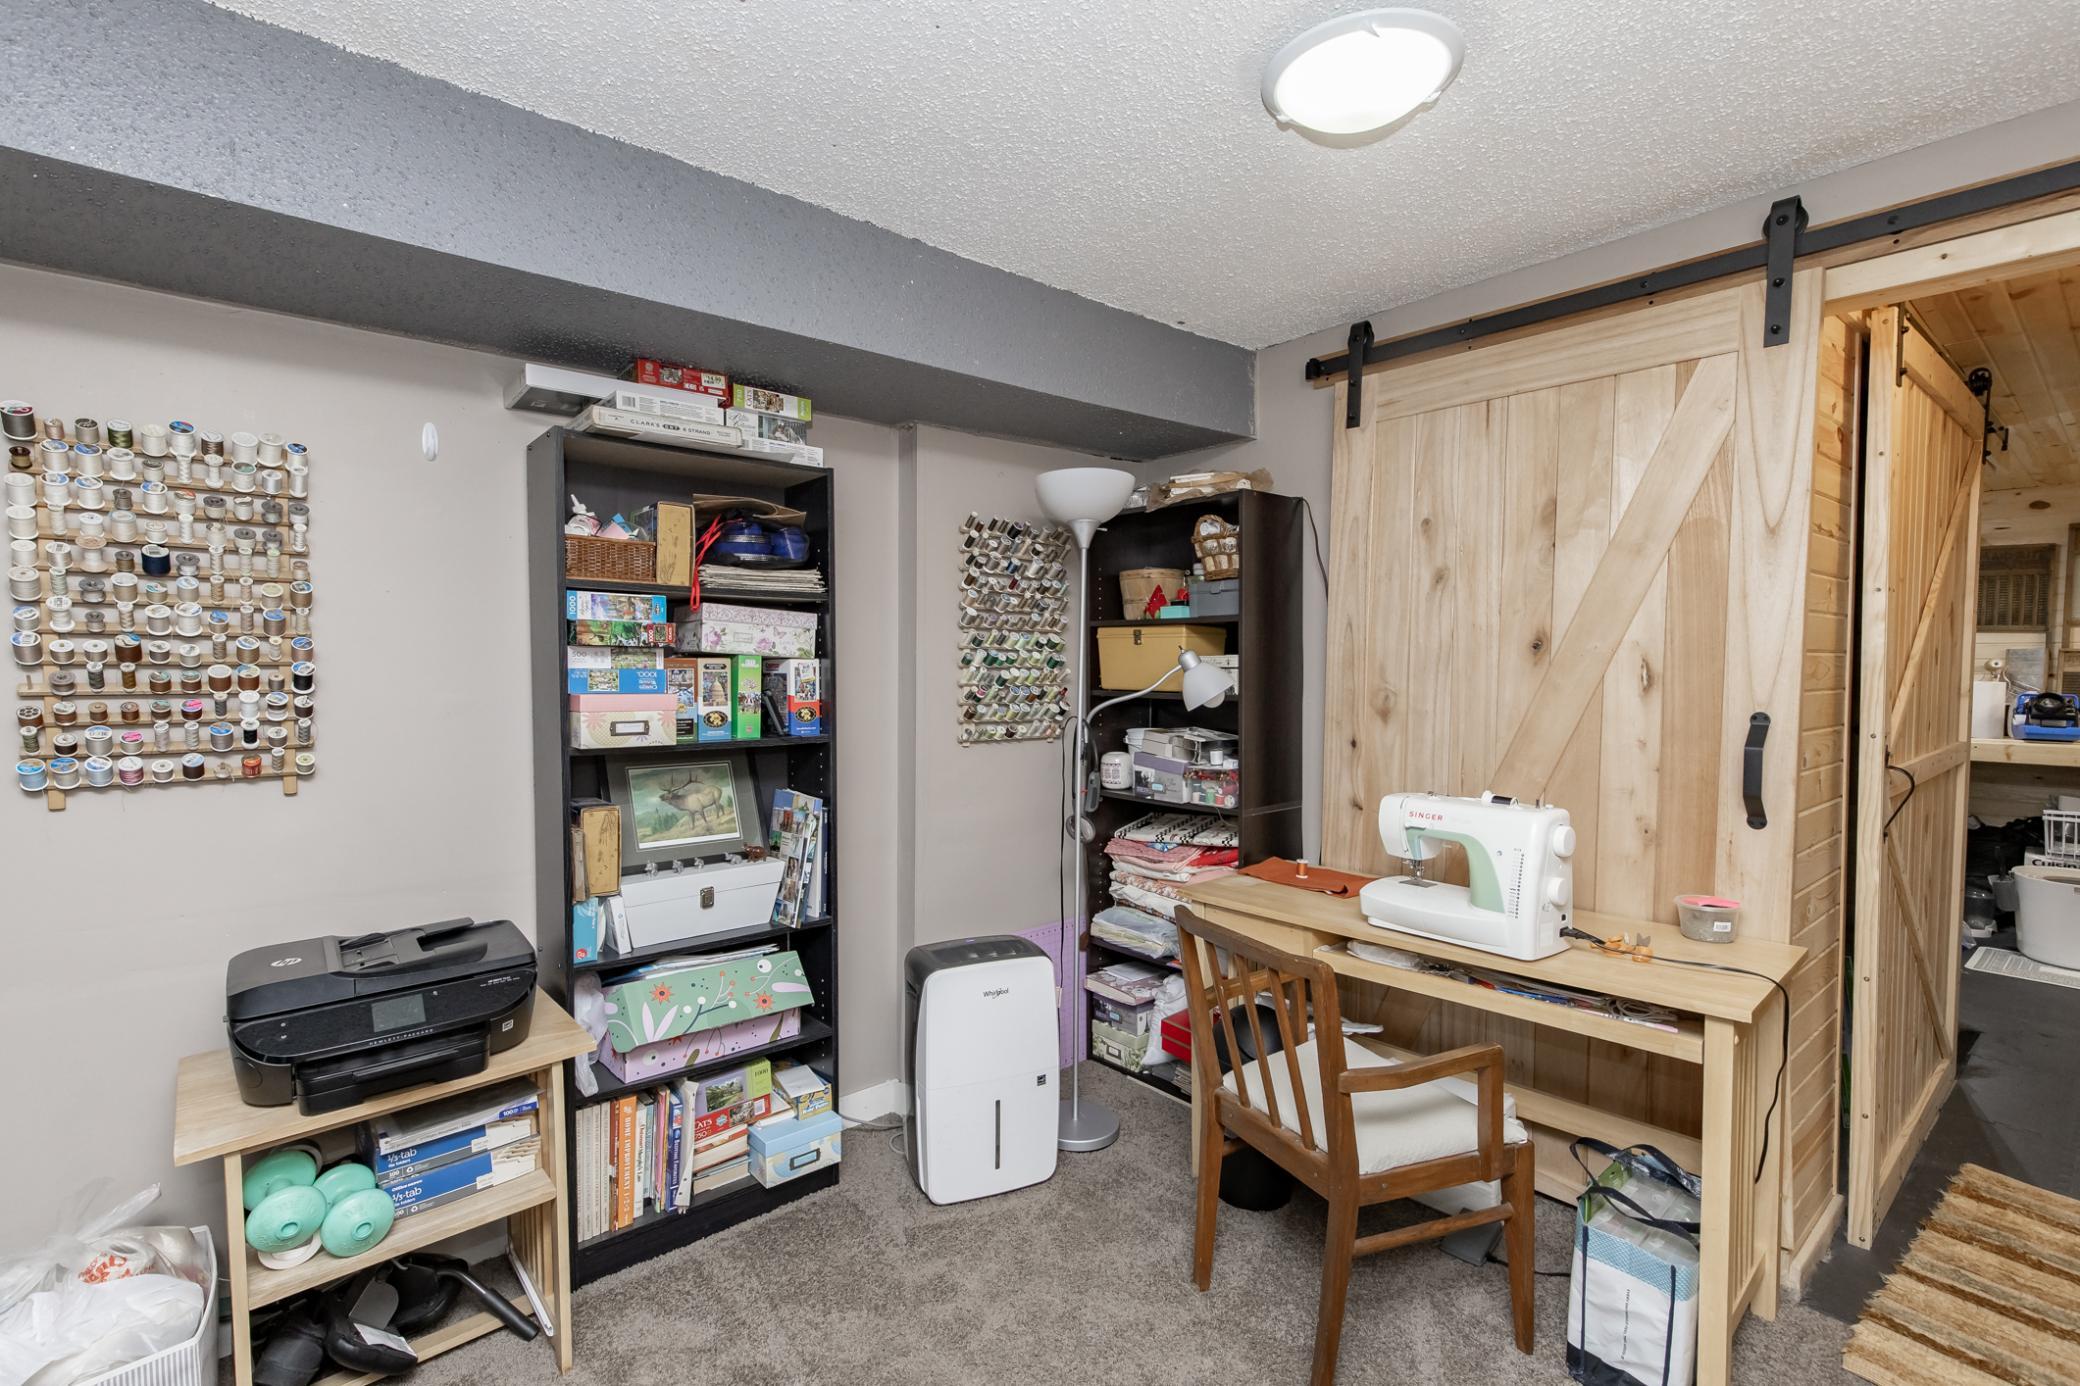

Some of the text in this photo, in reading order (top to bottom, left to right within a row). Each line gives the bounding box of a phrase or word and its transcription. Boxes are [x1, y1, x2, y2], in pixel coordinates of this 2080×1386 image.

[569, 595, 577, 615] 1000
[572, 650, 587, 659] 500
[1408, 811, 1444, 822] SINGER
[2031, 859, 2080, 869] Cuisin
[982, 987, 1009, 999] Whirlpool
[623, 1116, 632, 1137] HOME
[623, 1138, 632, 1190] IMPROVEMENT
